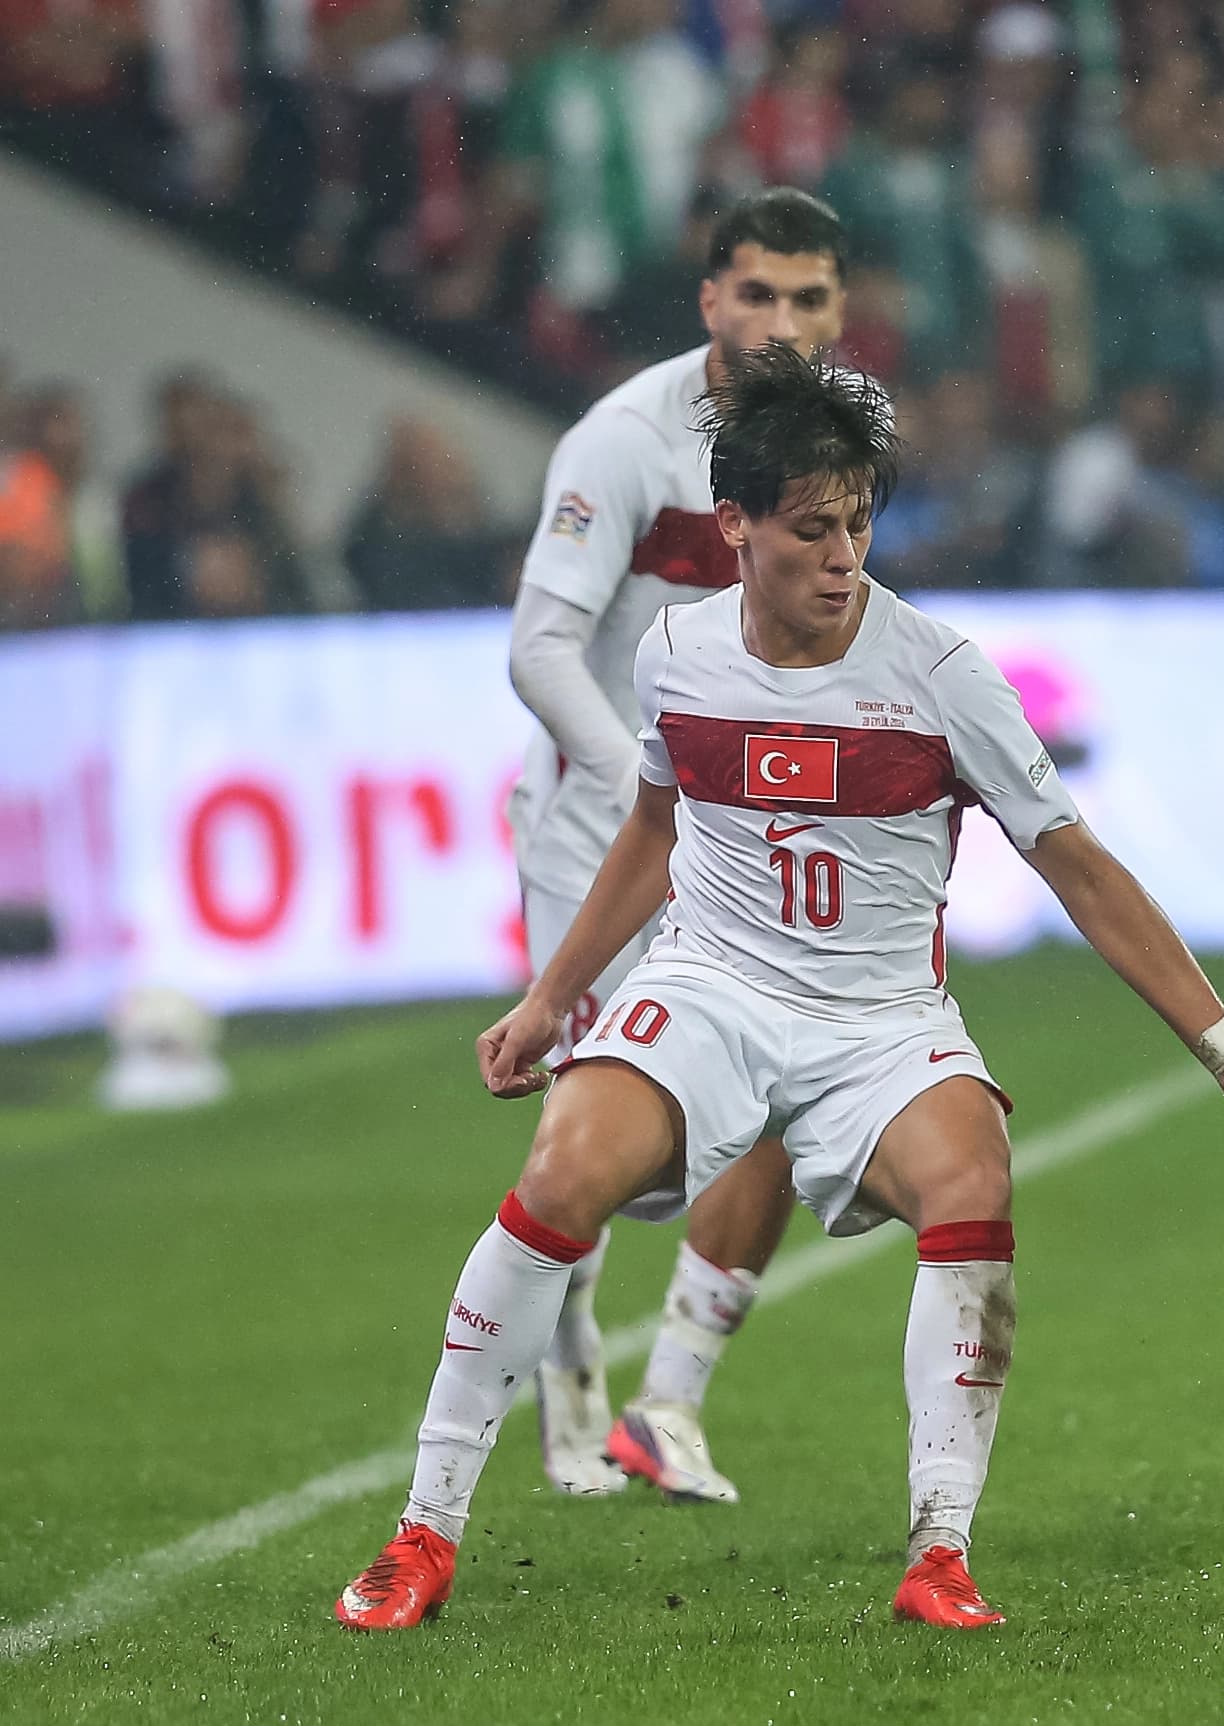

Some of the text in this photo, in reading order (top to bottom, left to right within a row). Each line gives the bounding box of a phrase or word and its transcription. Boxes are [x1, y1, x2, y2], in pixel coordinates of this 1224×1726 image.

[184, 775, 530, 975] or
[769, 847, 844, 932] 10
[595, 998, 672, 1048] 10
